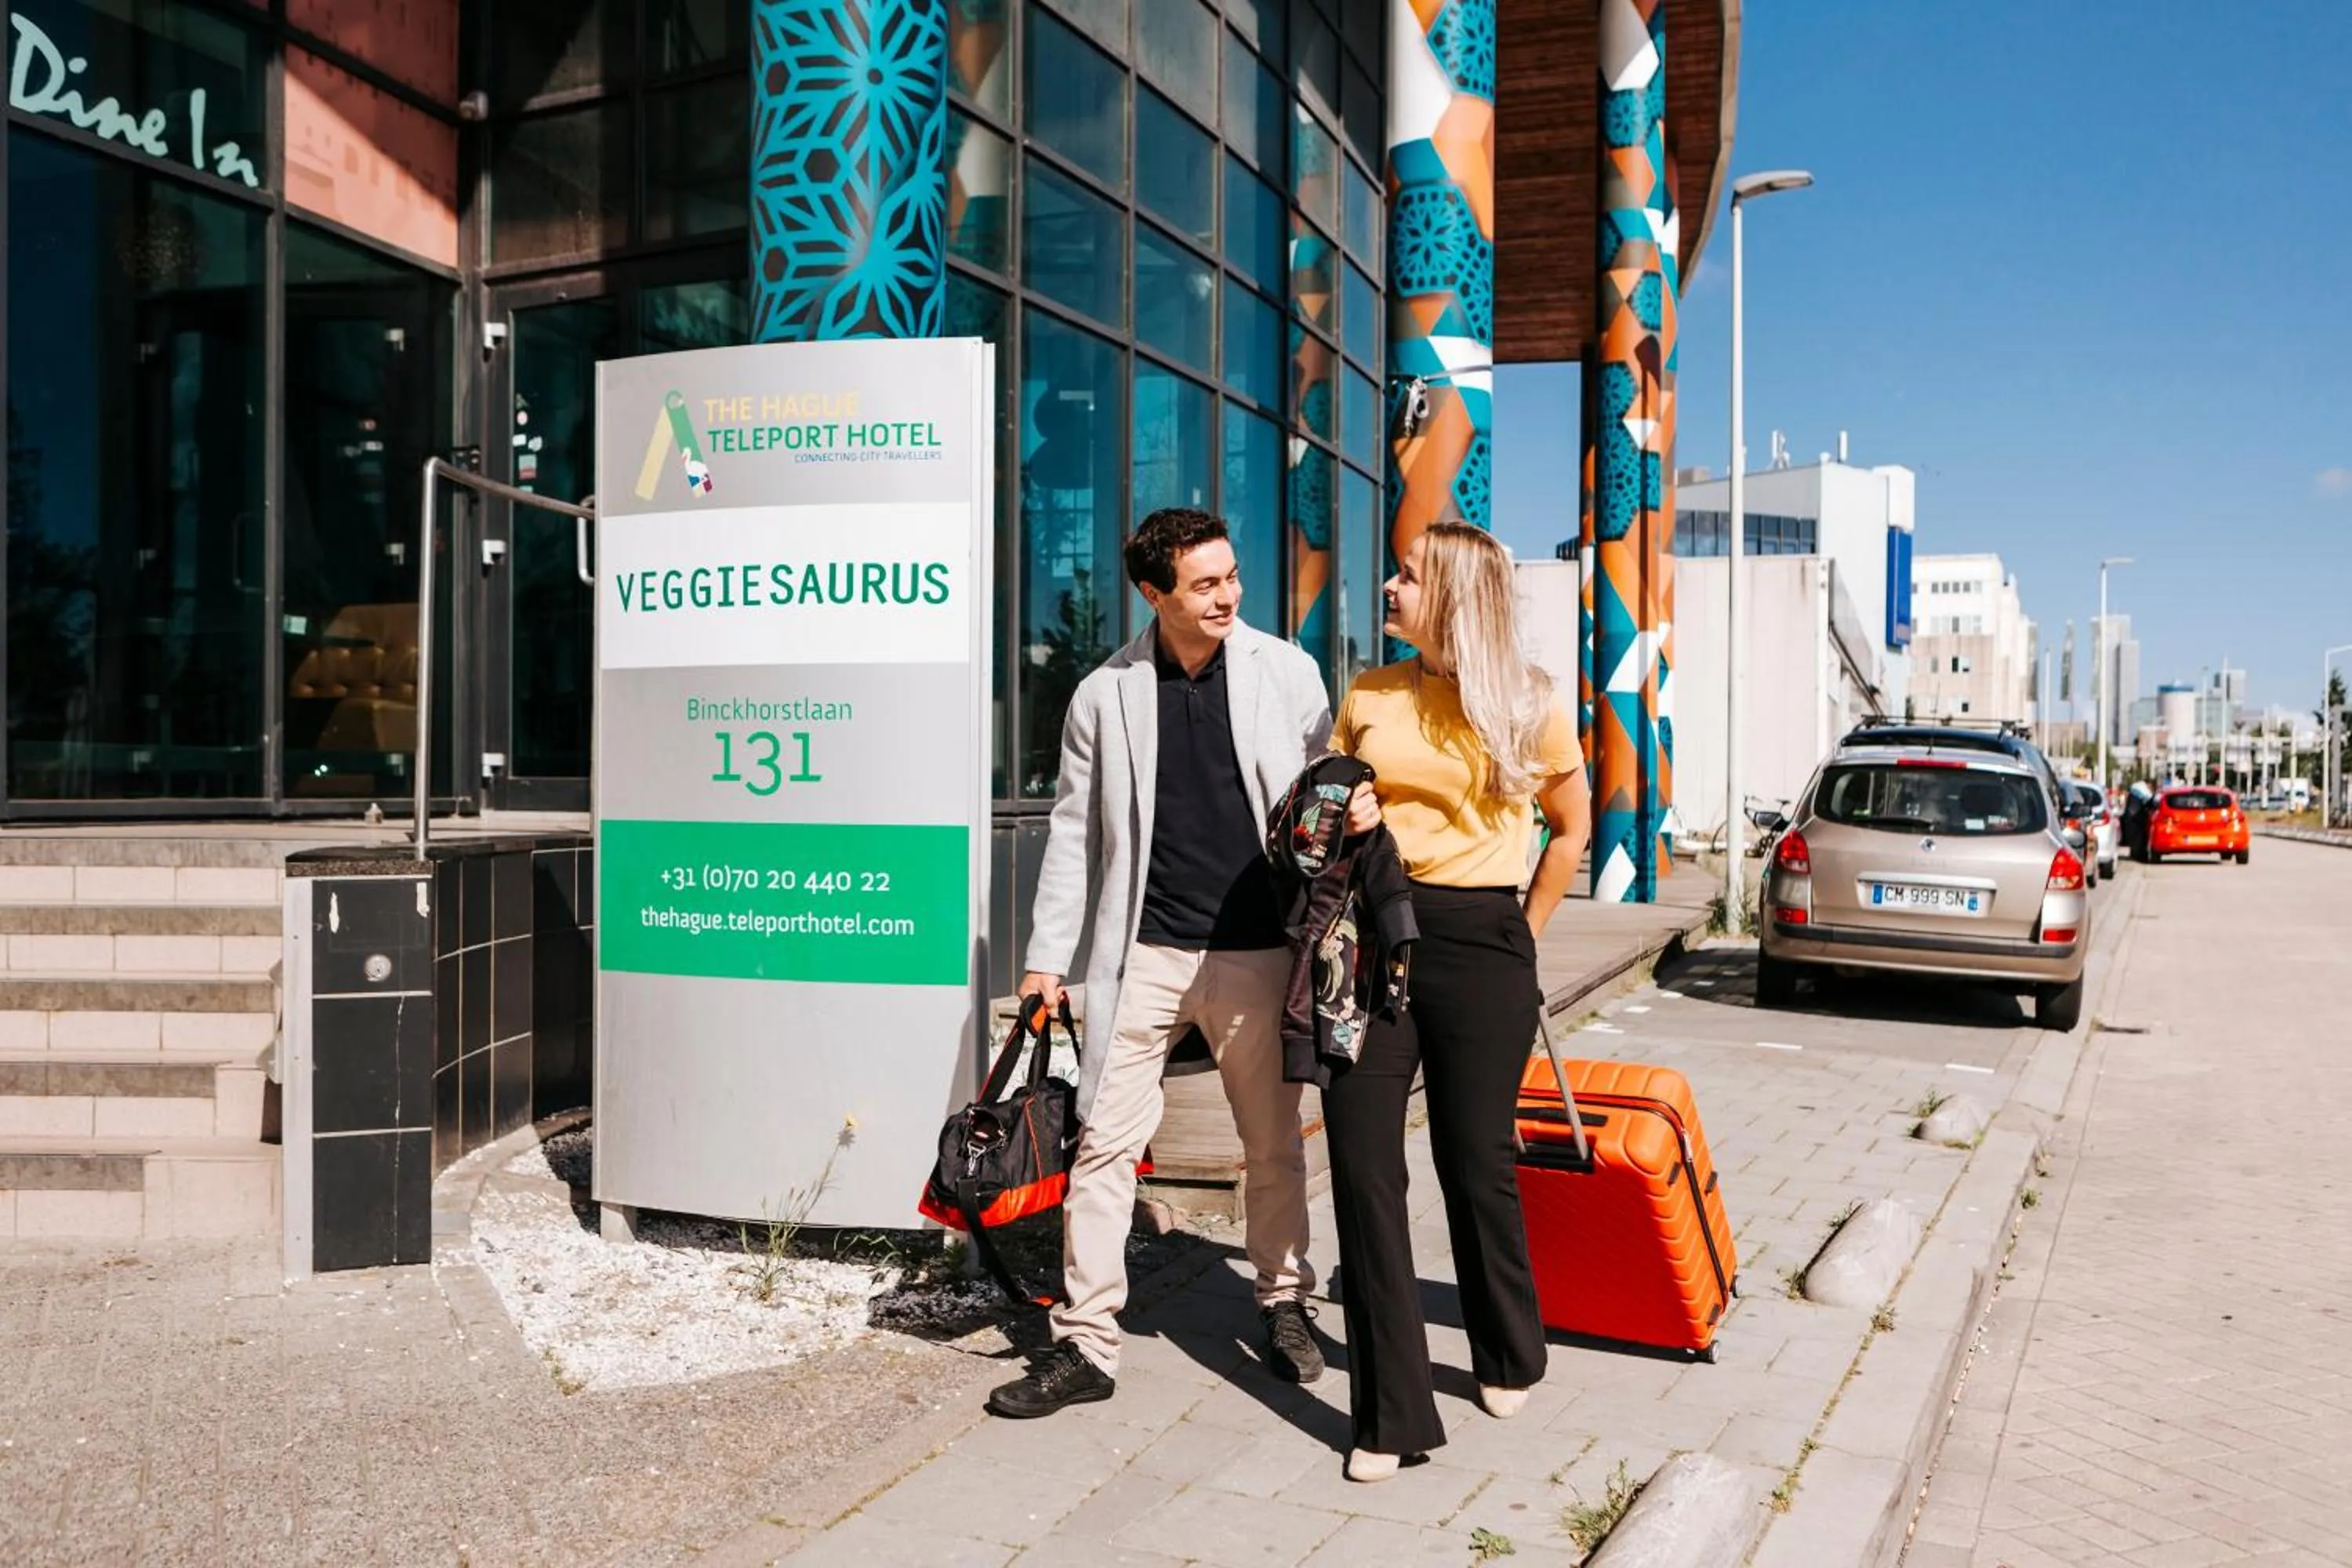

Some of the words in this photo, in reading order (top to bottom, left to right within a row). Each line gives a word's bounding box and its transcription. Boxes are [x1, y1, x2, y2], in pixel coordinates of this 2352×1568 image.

[10, 13, 167, 155] Dine
[191, 89, 259, 187] In
[704, 397, 753, 425] THE
[761, 392, 859, 422] HAGUE
[707, 424, 839, 452] TELEPORT
[846, 422, 942, 449] HOTEL
[795, 452, 858, 463] CONNECTING
[861, 451, 881, 462] CITY
[883, 450, 943, 461] TRAVELLERS
[616, 561, 950, 614] VEGGIESAURUS
[686, 696, 853, 722] Binckhorstlaan
[710, 730, 825, 797] 131
[660, 867, 695, 891] +31
[702, 865, 758, 892] (0)70
[767, 869, 796, 890] 20
[804, 871, 851, 895] 440
[861, 872, 891, 892] 22
[641, 906, 914, 937] thehague.teleporthotel.com
